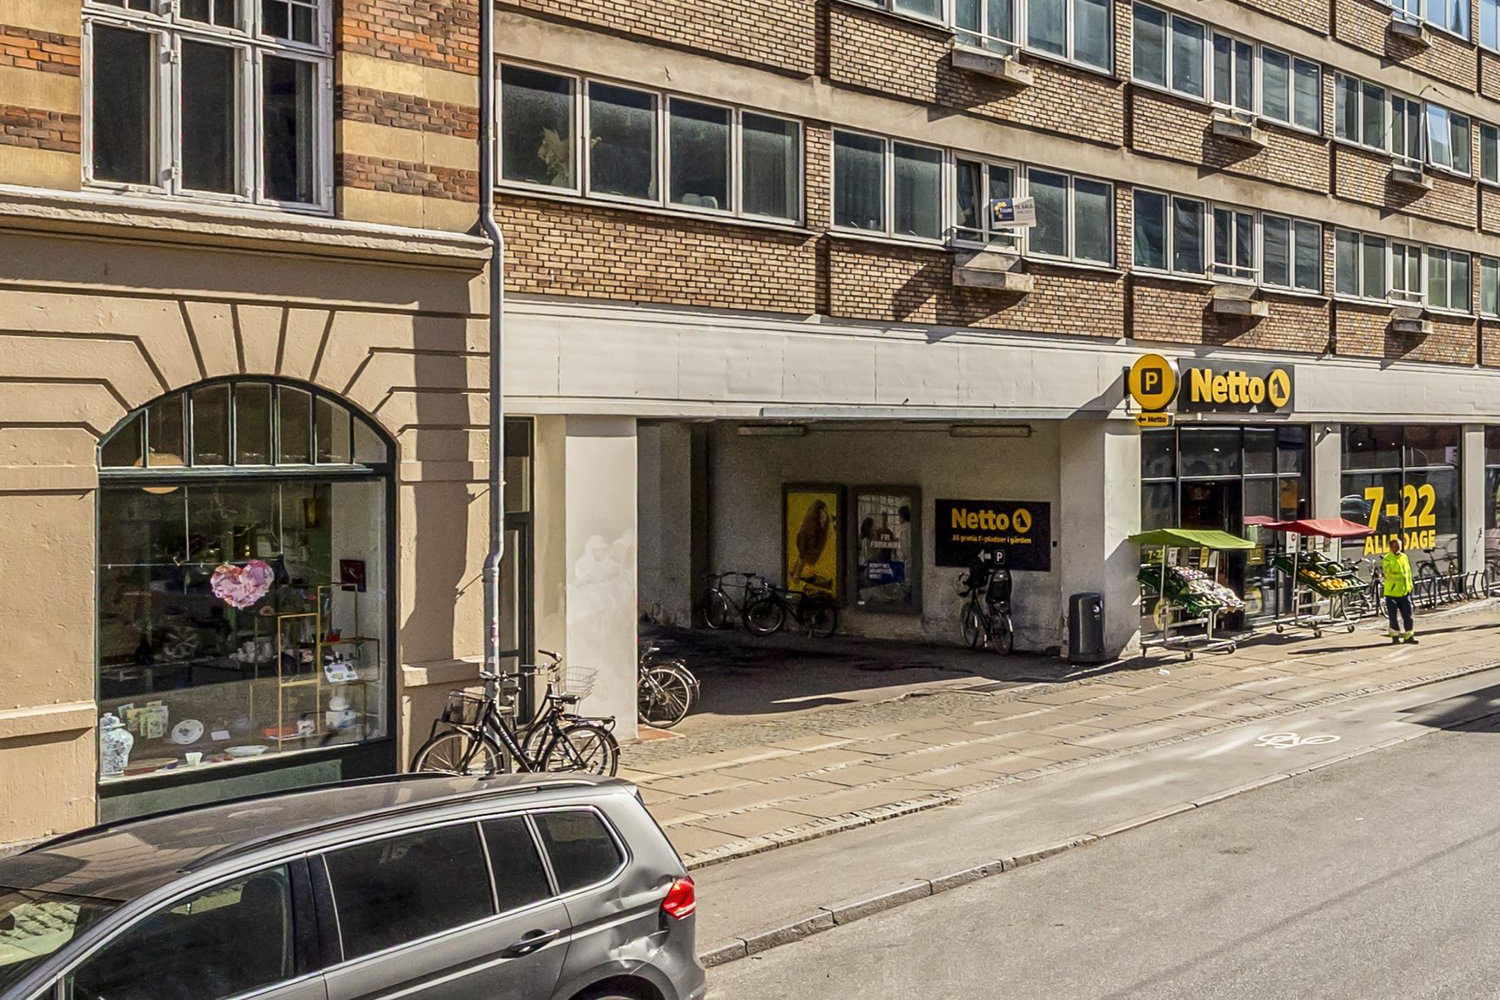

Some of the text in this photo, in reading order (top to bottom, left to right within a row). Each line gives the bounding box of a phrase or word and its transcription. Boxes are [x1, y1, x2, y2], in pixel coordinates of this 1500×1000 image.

[1145, 371, 1159, 392] P
[1190, 367, 1266, 405] Netto
[1147, 415, 1167, 423] Netto
[1364, 483, 1436, 532] 7-22
[951, 507, 1010, 531] Netto
[996, 551, 1004, 562] P
